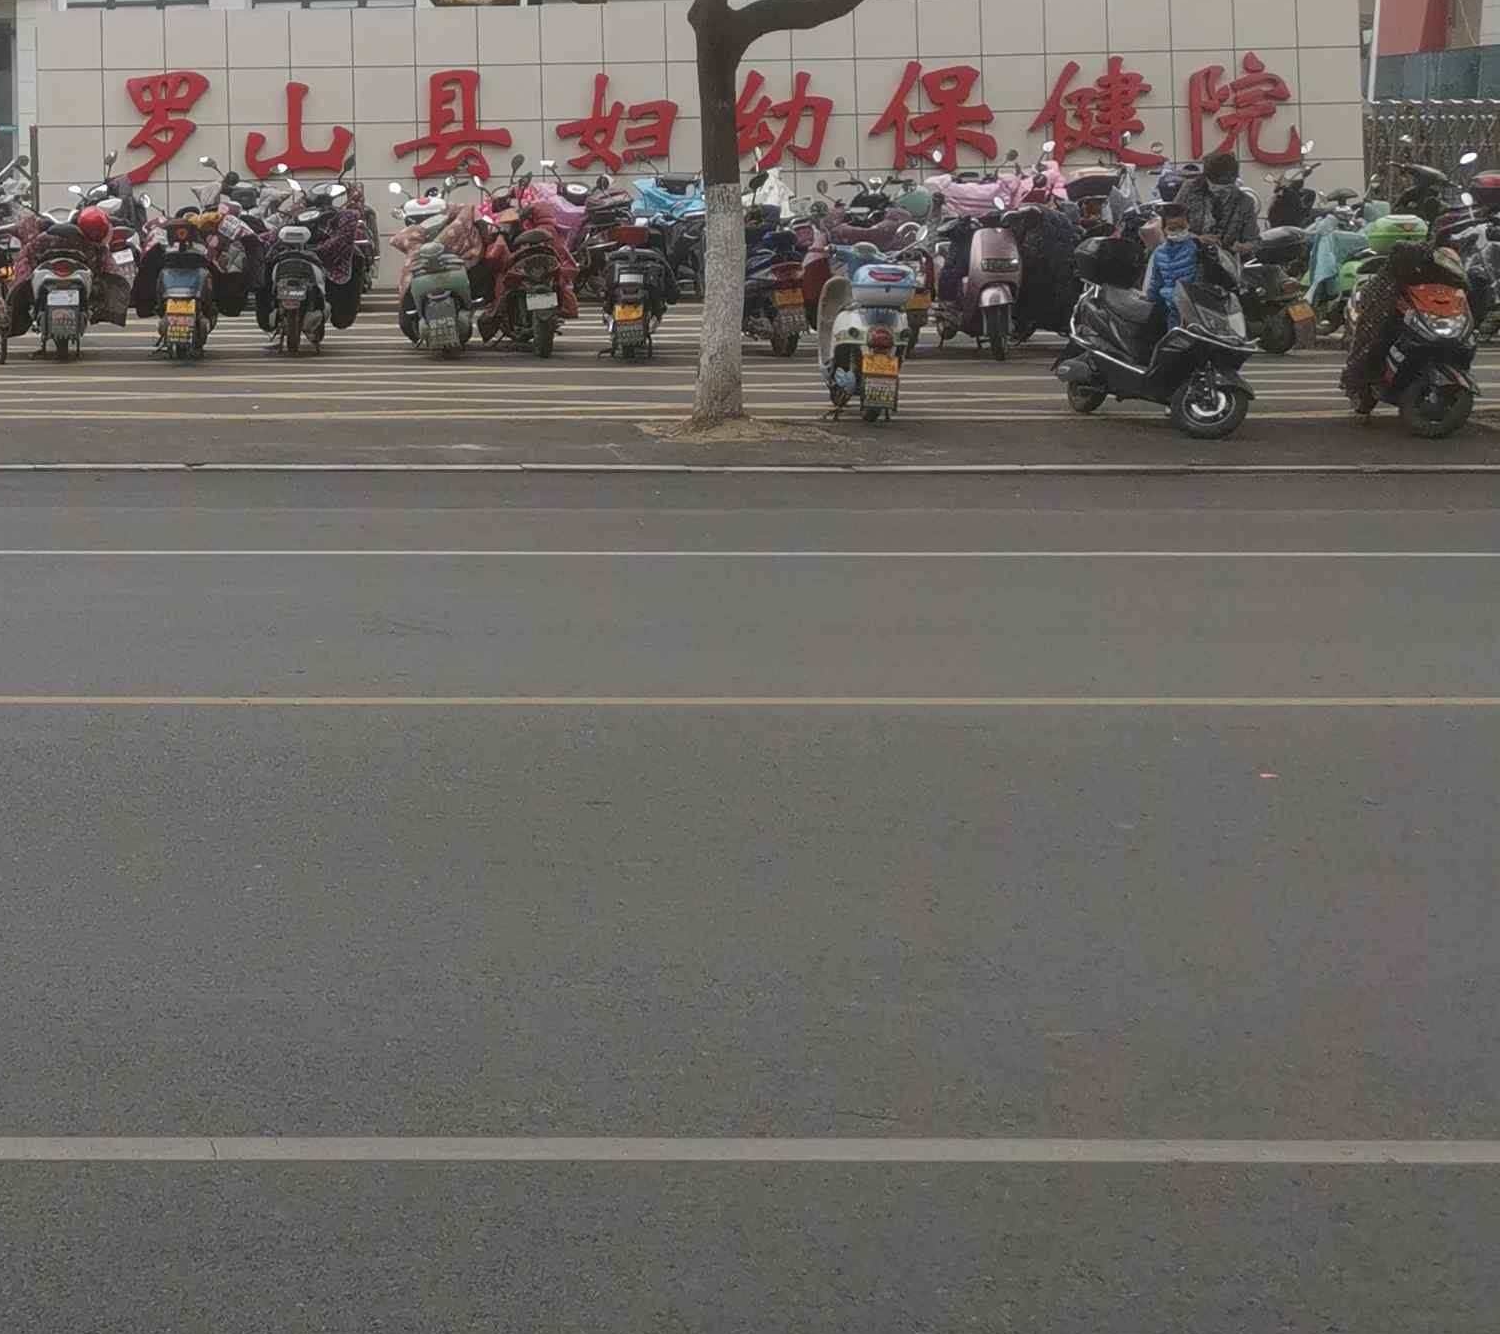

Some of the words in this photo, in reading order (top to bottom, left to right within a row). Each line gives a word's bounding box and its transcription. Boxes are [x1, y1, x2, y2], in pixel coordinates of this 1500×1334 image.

[126, 51, 1303, 185] 罗山县妇幼保健院
